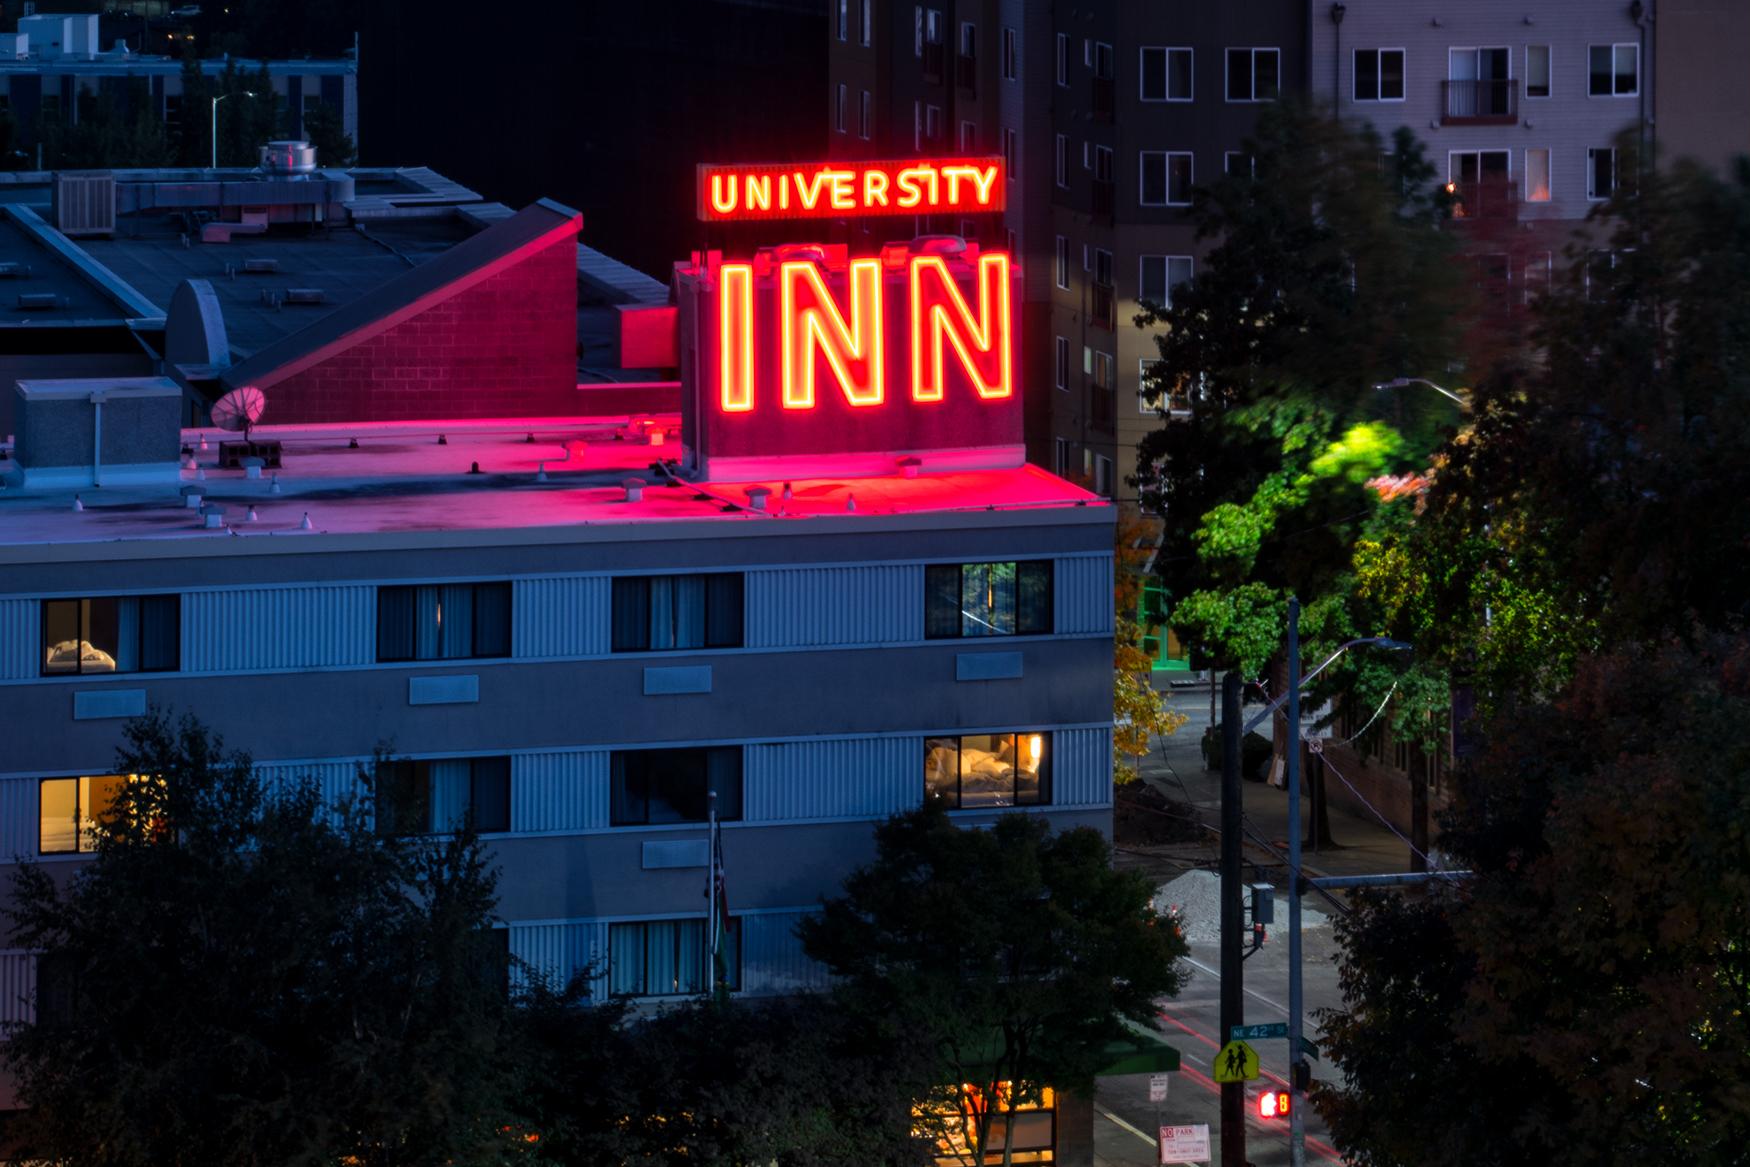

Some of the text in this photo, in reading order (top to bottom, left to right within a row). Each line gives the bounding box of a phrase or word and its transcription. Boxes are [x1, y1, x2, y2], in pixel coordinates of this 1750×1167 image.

[711, 166, 998, 213] UNIVERSITY
[719, 252, 1012, 412] INN
[1233, 1029, 1244, 1038] NE
[1161, 1128, 1174, 1137] NO
